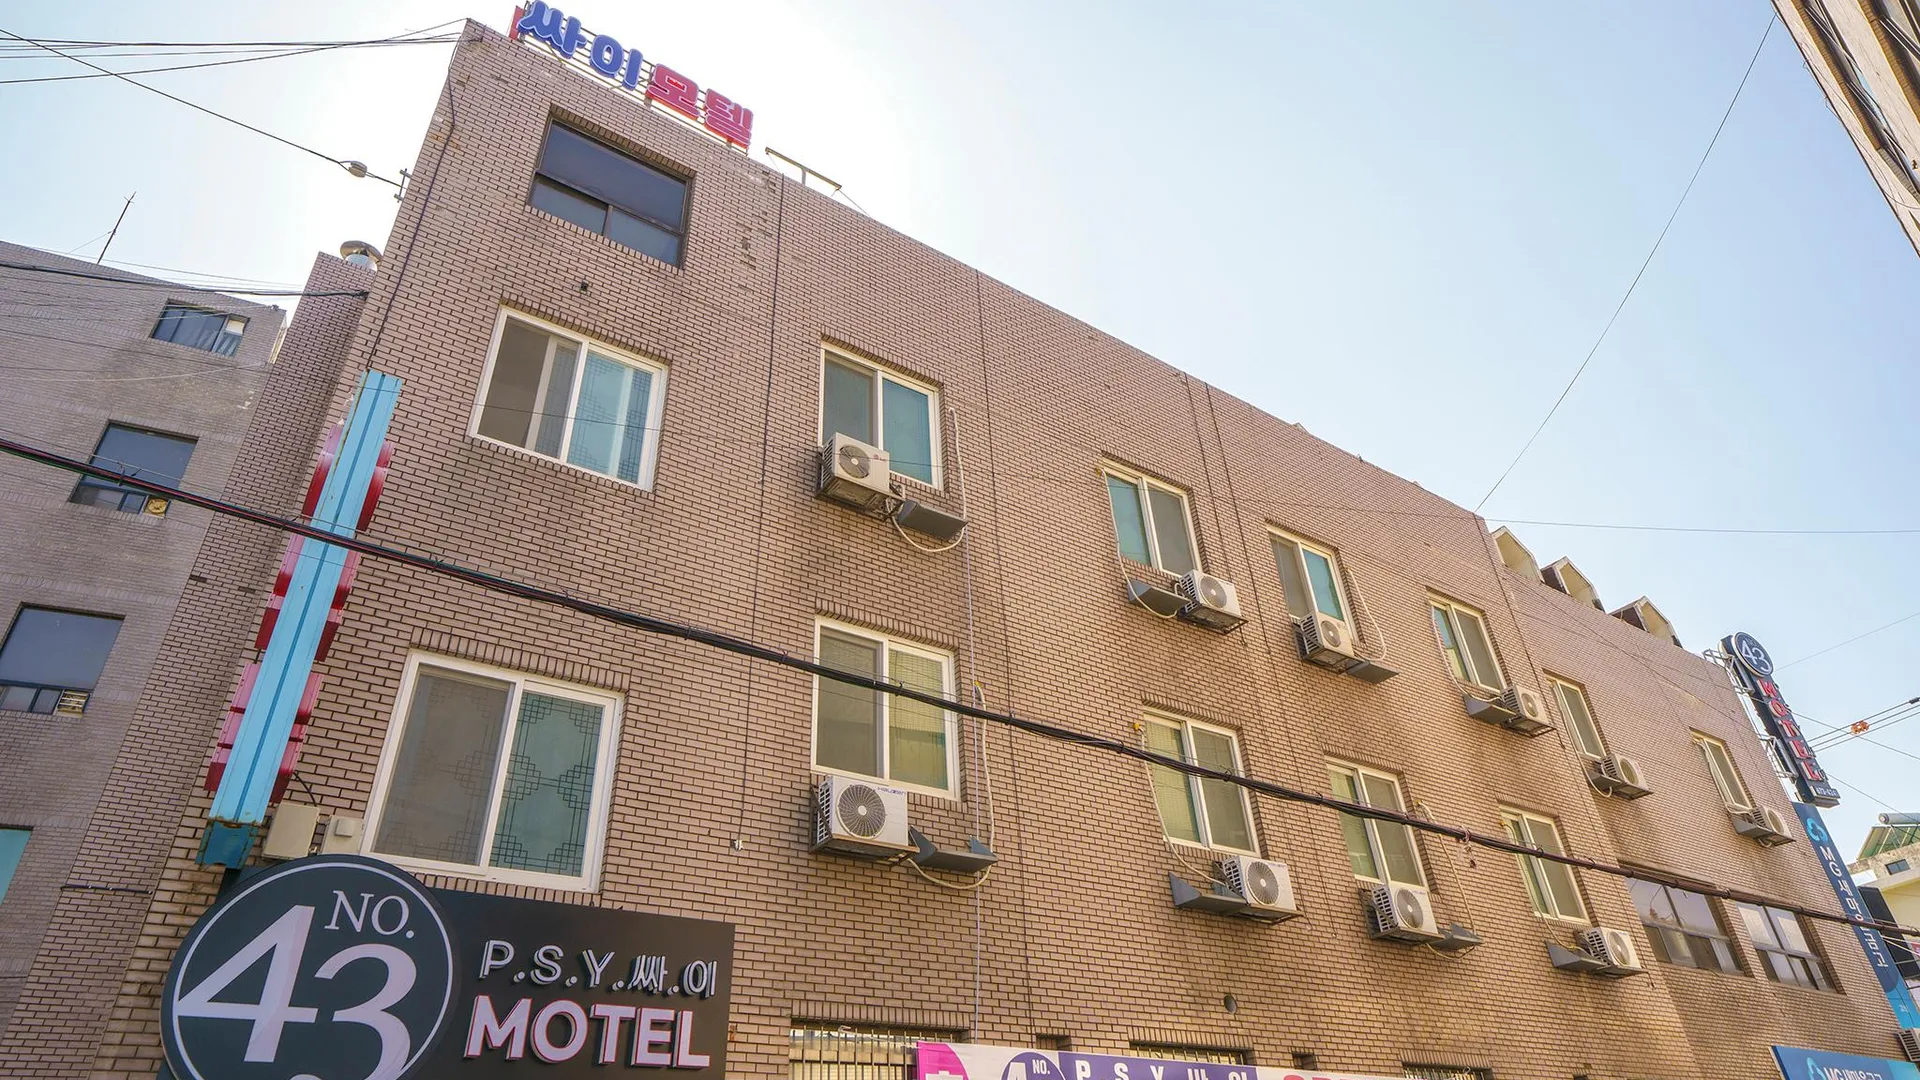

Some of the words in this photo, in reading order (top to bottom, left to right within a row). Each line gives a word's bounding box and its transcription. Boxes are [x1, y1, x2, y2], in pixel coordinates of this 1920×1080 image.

[1742, 640, 1771, 672] 43
[1757, 679, 1823, 781] MOTEL
[325, 890, 414, 938] NO.
[178, 904, 417, 1080] 43
[464, 995, 710, 1068] MOTEL
[1032, 1060, 1050, 1074] NO.
